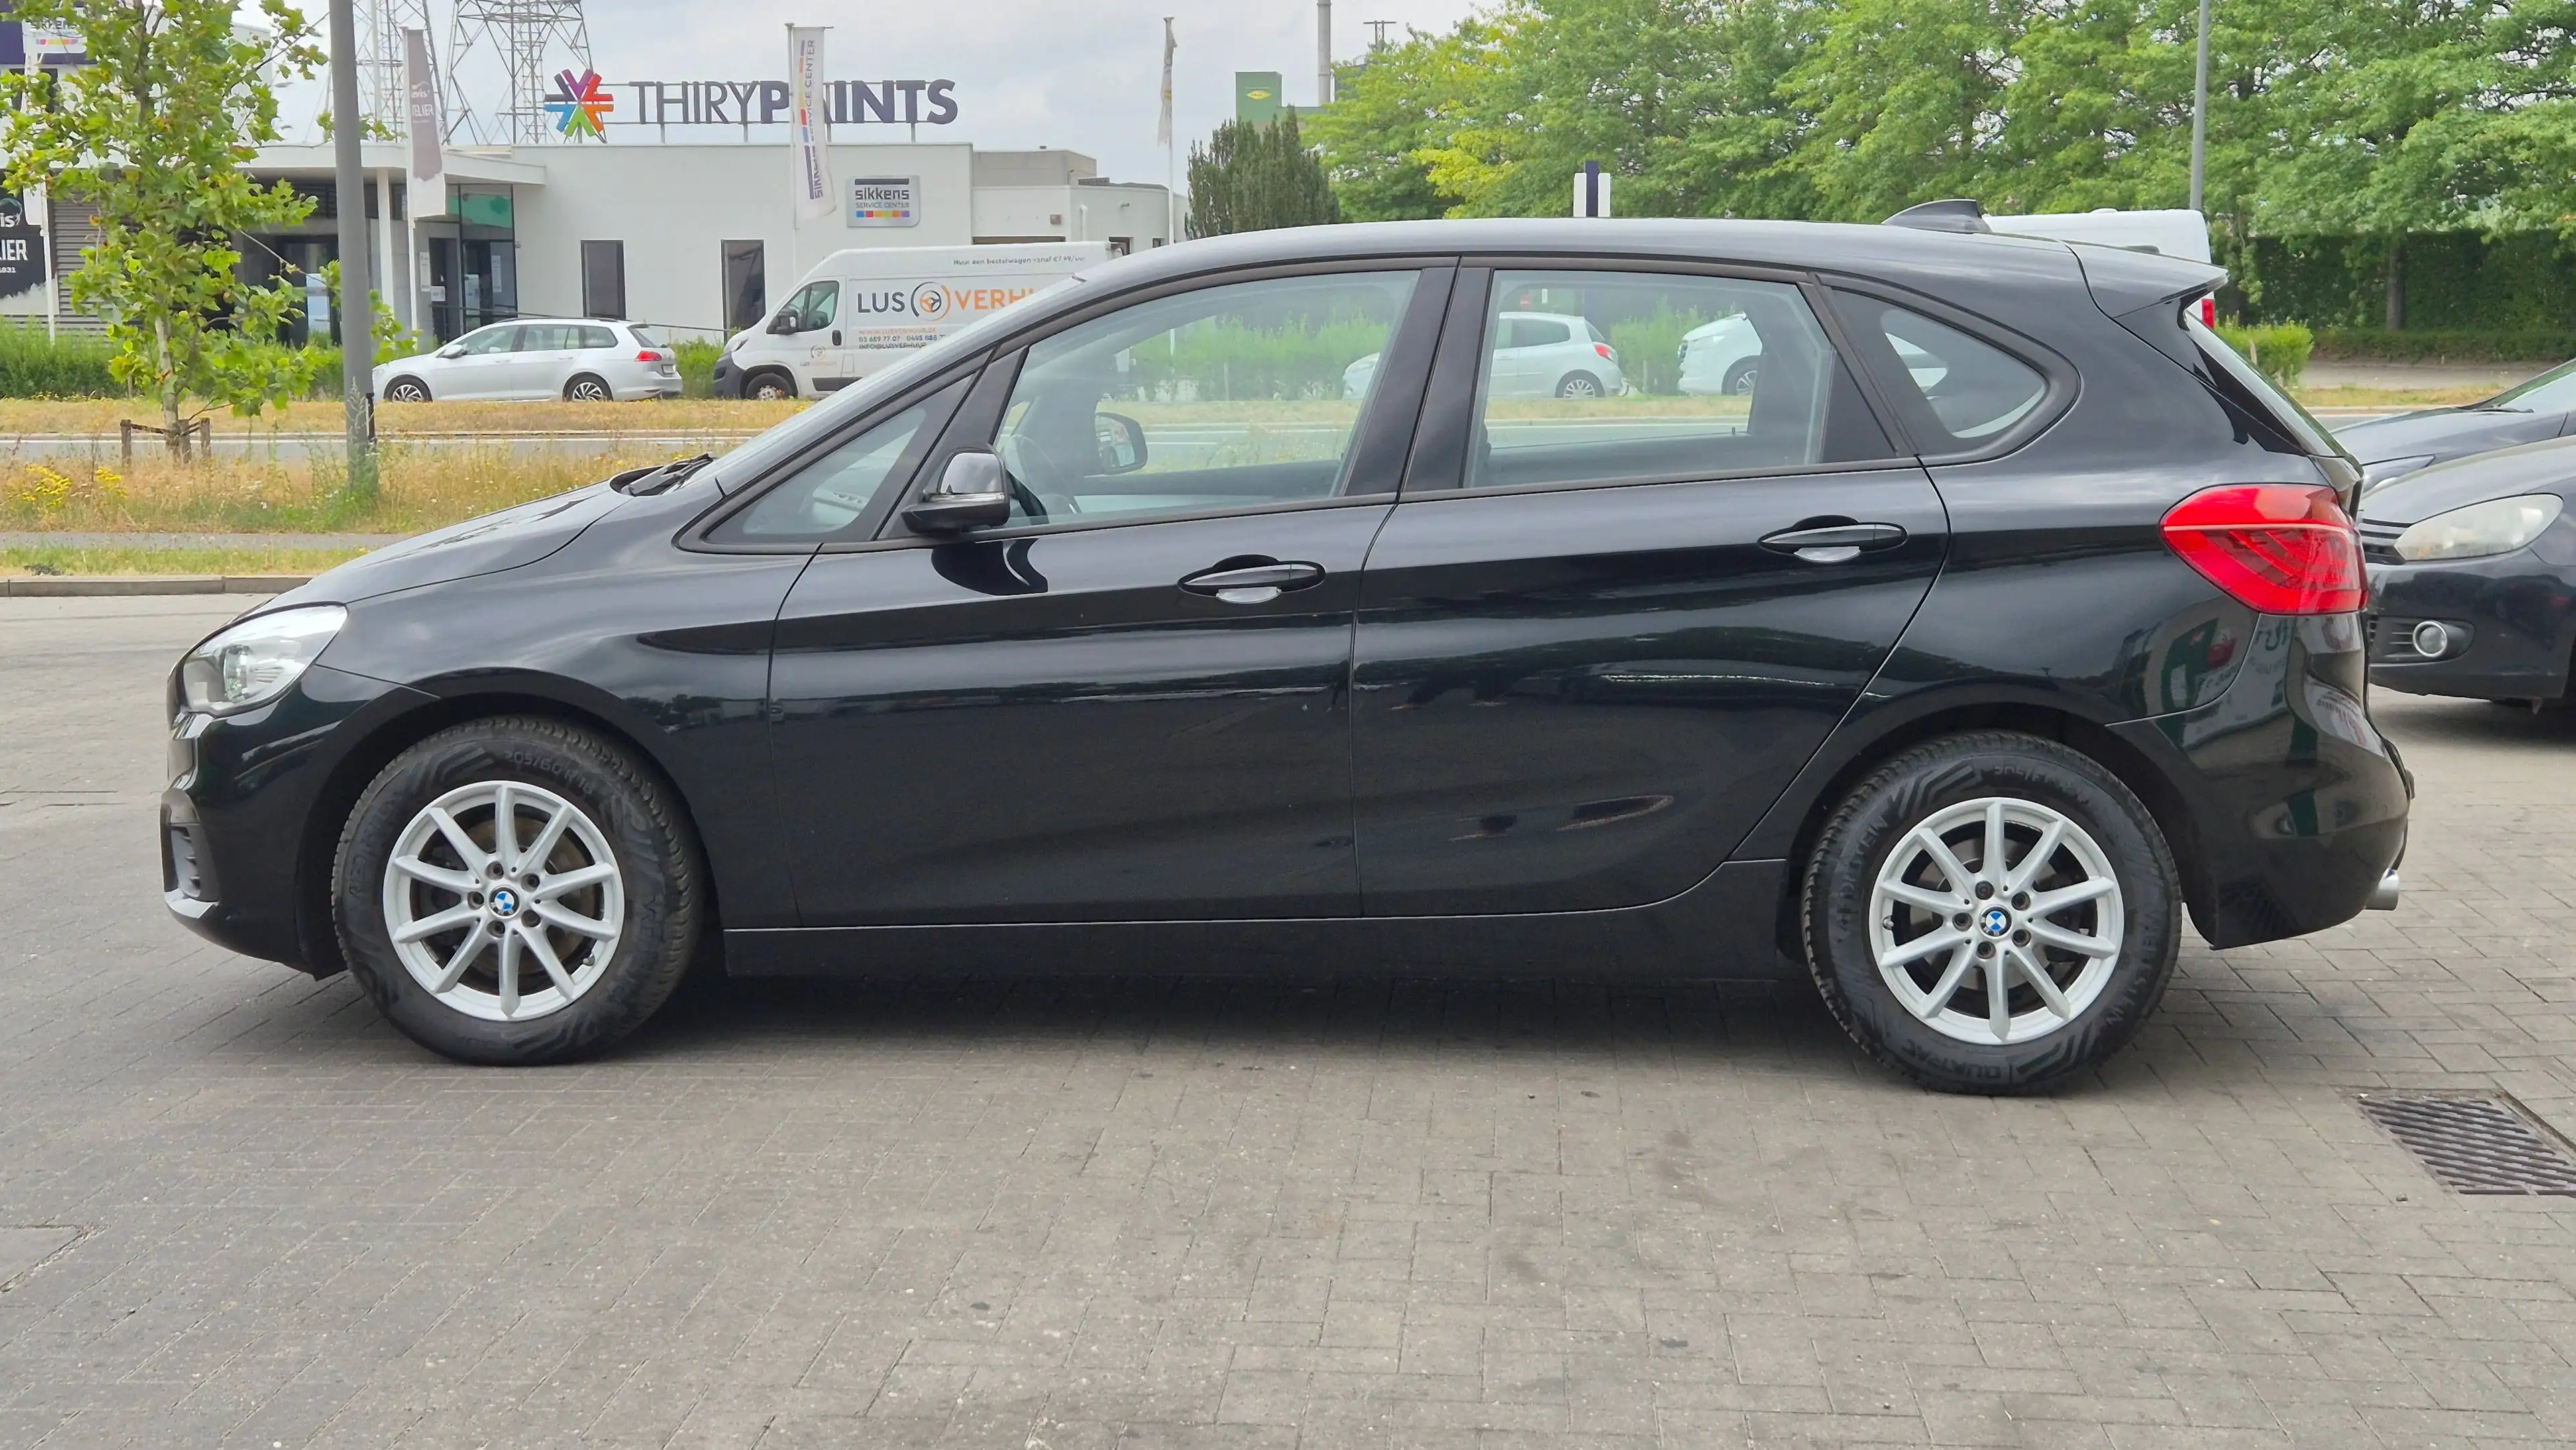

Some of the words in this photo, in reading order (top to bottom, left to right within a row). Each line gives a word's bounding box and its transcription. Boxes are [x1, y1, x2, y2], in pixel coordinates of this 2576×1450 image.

[805, 40, 815, 90] CENTER
[629, 79, 959, 124] THIRYPINTS
[855, 187, 910, 200] sikkens
[0, 239, 28, 261] IER
[857, 292, 905, 313] LUS
[955, 288, 1034, 310] VERH
